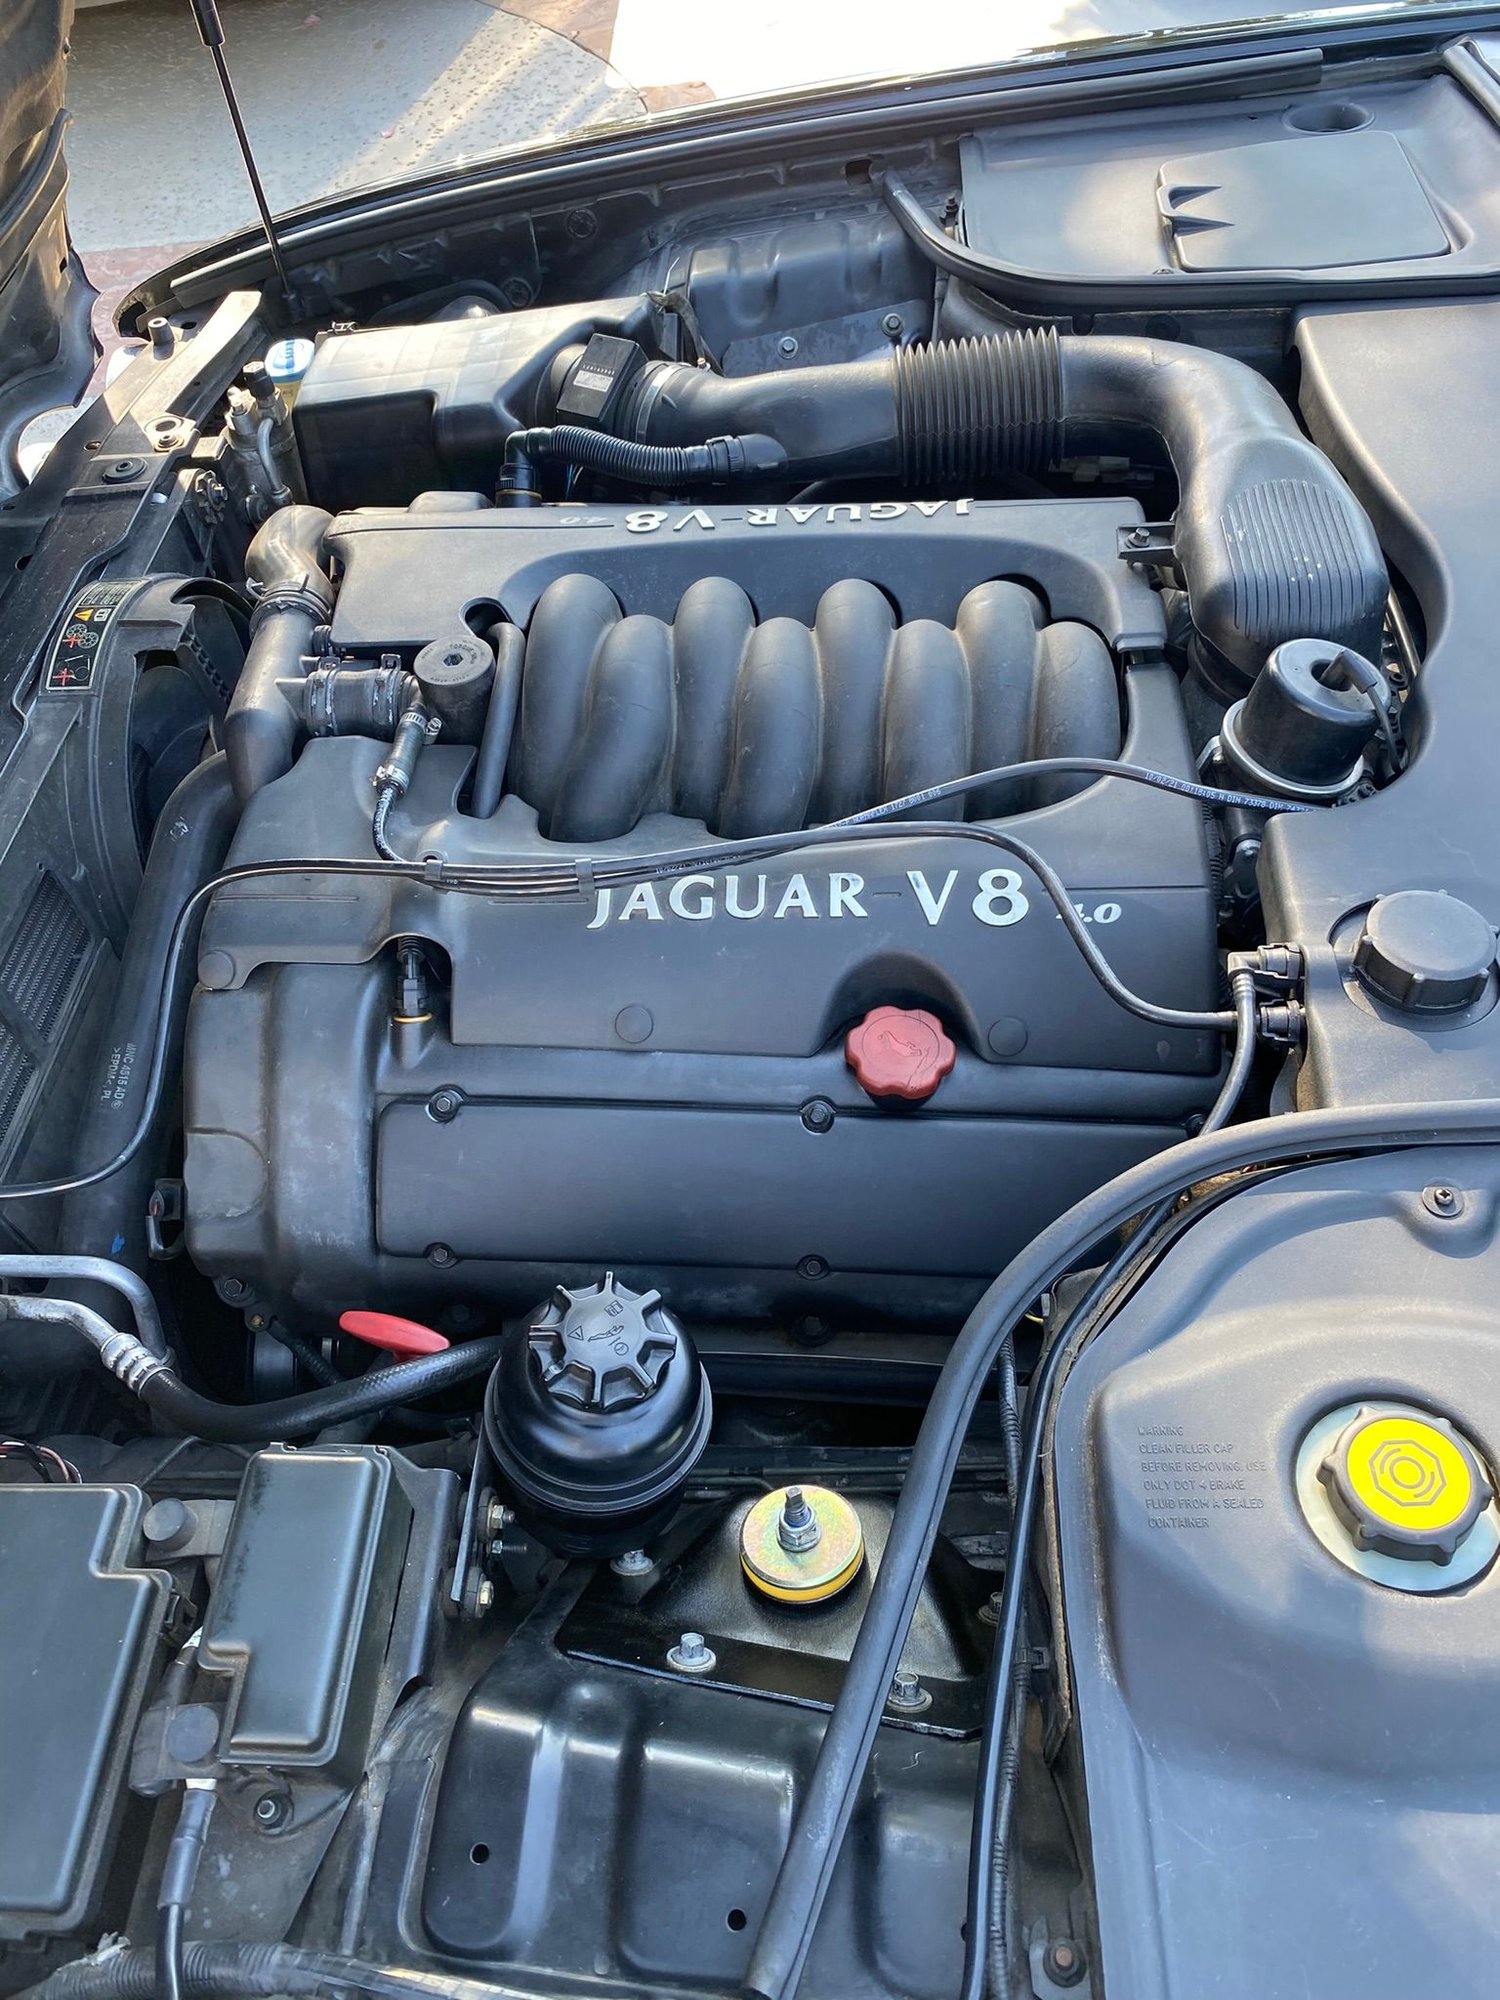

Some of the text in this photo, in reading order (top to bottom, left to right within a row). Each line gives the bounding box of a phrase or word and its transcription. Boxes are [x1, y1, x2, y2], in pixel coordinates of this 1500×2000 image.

[747, 498, 975, 526] JAGUAR
[586, 872, 868, 929] JAGUAR
[1137, 1425, 1184, 1437] WARNING
[1140, 1443, 1235, 1455] CLEAN FILLER CAP
[1142, 1461, 1182, 1472] BEFORE
[1246, 1461, 1267, 1472] USE
[1144, 1480, 1171, 1491] ONLY
[1174, 1480, 1196, 1491] DOT
[1209, 1480, 1246, 1491] BRAKE
[1146, 1499, 1176, 1509] FLUID
[1179, 1499, 1210, 1509] FROM
[1223, 1499, 1265, 1509] SEALED
[1148, 1518, 1209, 1529] CONTAINER
